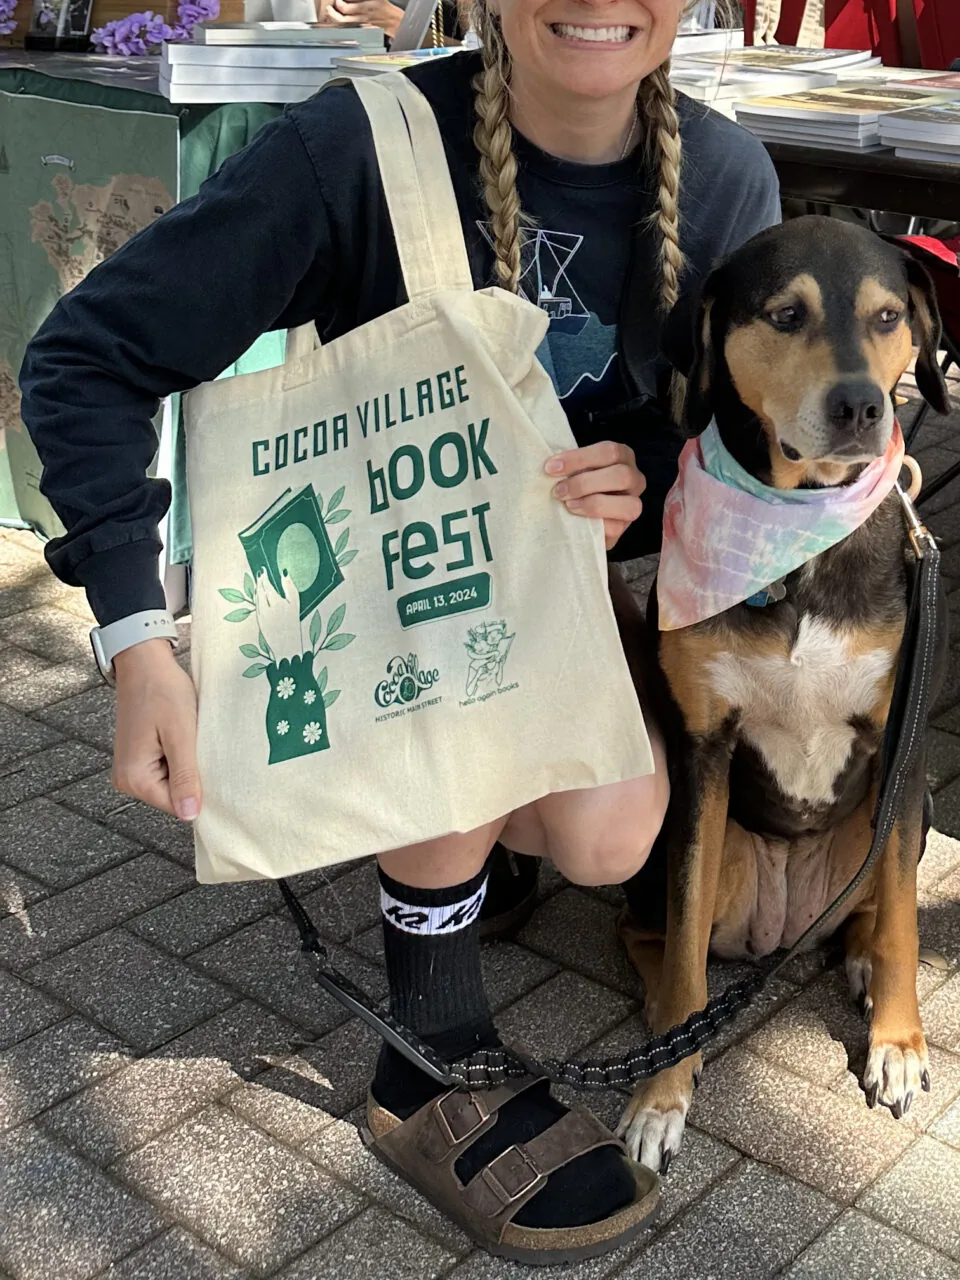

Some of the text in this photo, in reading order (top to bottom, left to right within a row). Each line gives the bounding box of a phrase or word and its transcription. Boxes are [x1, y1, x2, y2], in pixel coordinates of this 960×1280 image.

[252, 364, 470, 477] COCOA VILLAGE
[406, 586, 477, 616] APRIL 13, 2024
[497, 681, 520, 694] books
[375, 696, 443, 723] HISTORIC MAIN STREET
